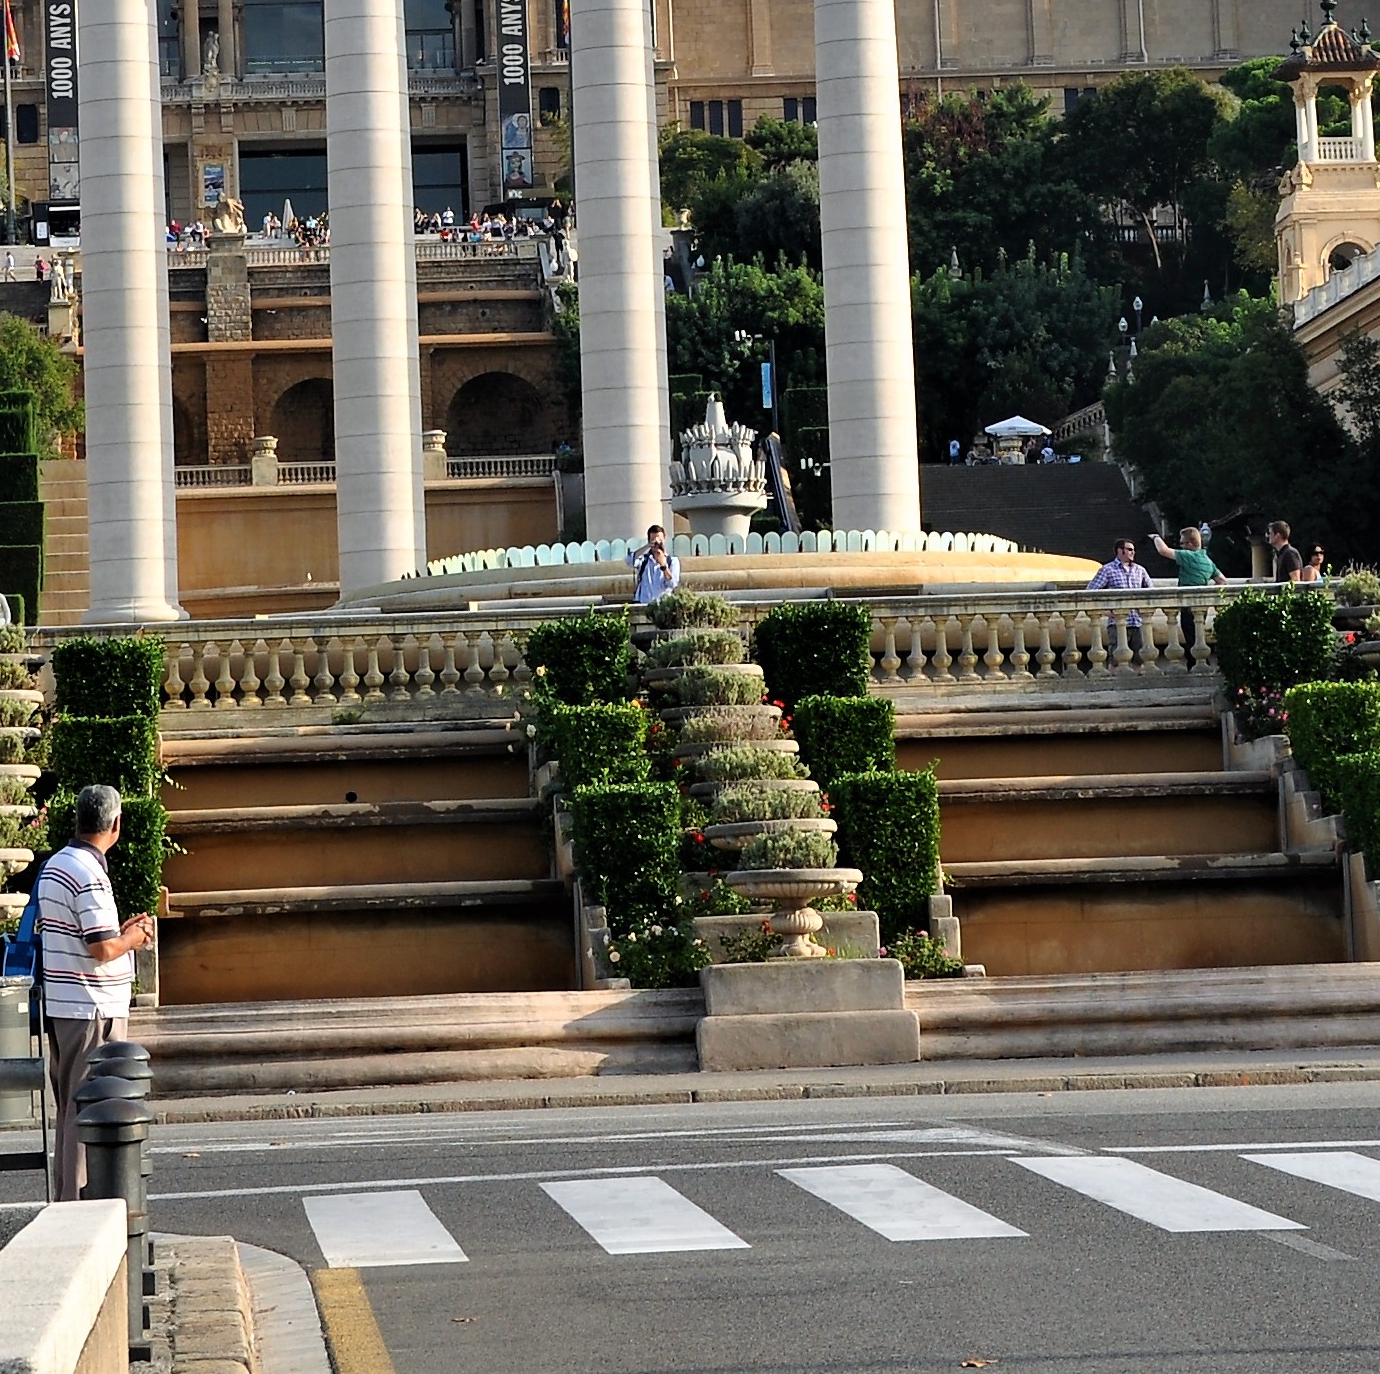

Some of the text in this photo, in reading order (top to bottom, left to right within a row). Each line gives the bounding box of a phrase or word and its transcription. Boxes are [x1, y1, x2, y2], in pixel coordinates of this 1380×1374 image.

[48, 3, 73, 50] ANYS
[50, 56, 74, 100] 1000
[503, 43, 525, 85] 1000
